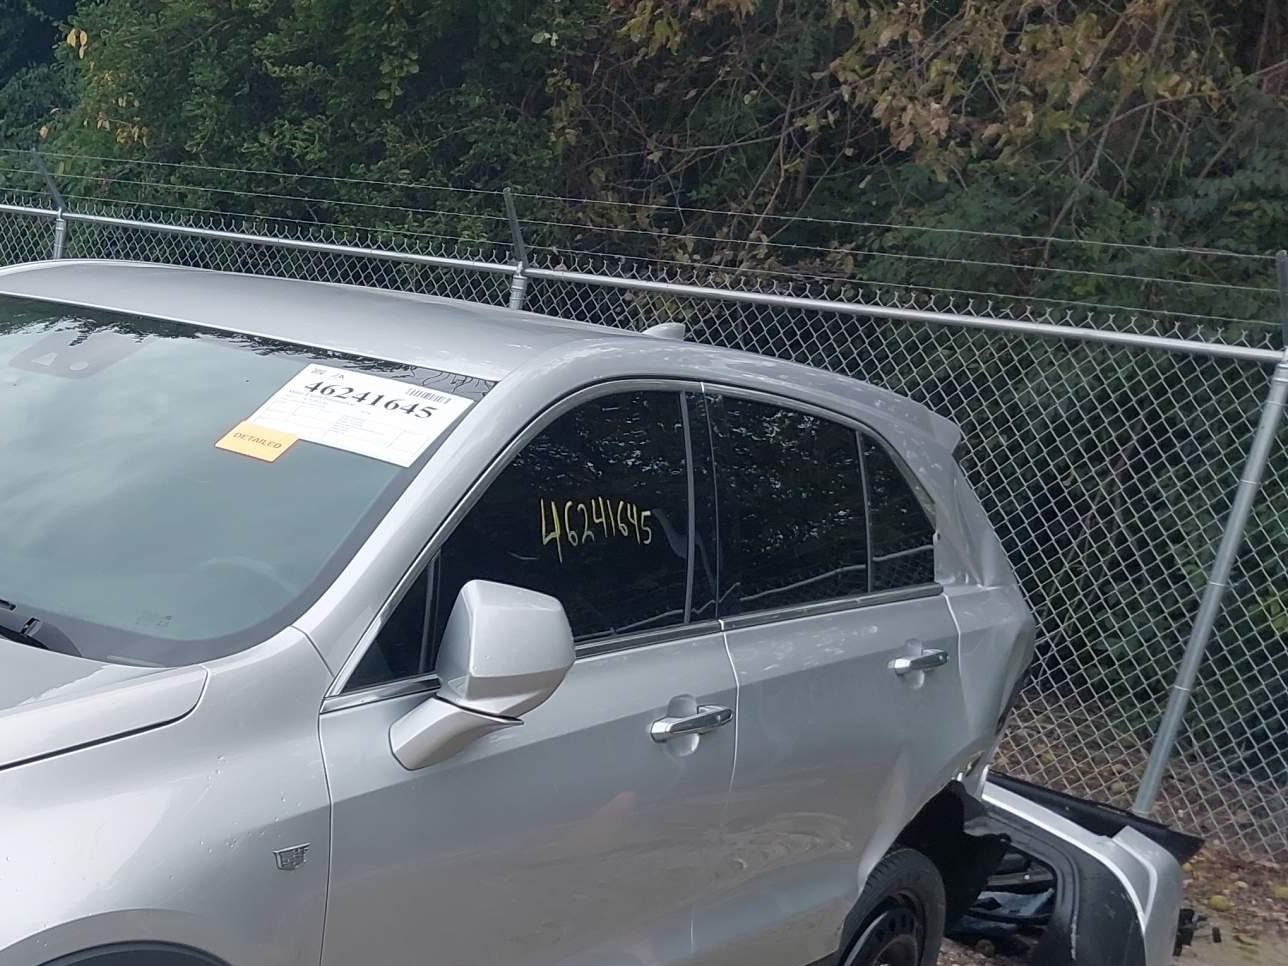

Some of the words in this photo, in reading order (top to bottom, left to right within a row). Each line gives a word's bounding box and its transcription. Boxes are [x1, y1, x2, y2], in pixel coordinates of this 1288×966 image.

[304, 380, 441, 420] 46241645
[232, 431, 283, 450] DETAILED
[540, 496, 652, 564] 46241645
